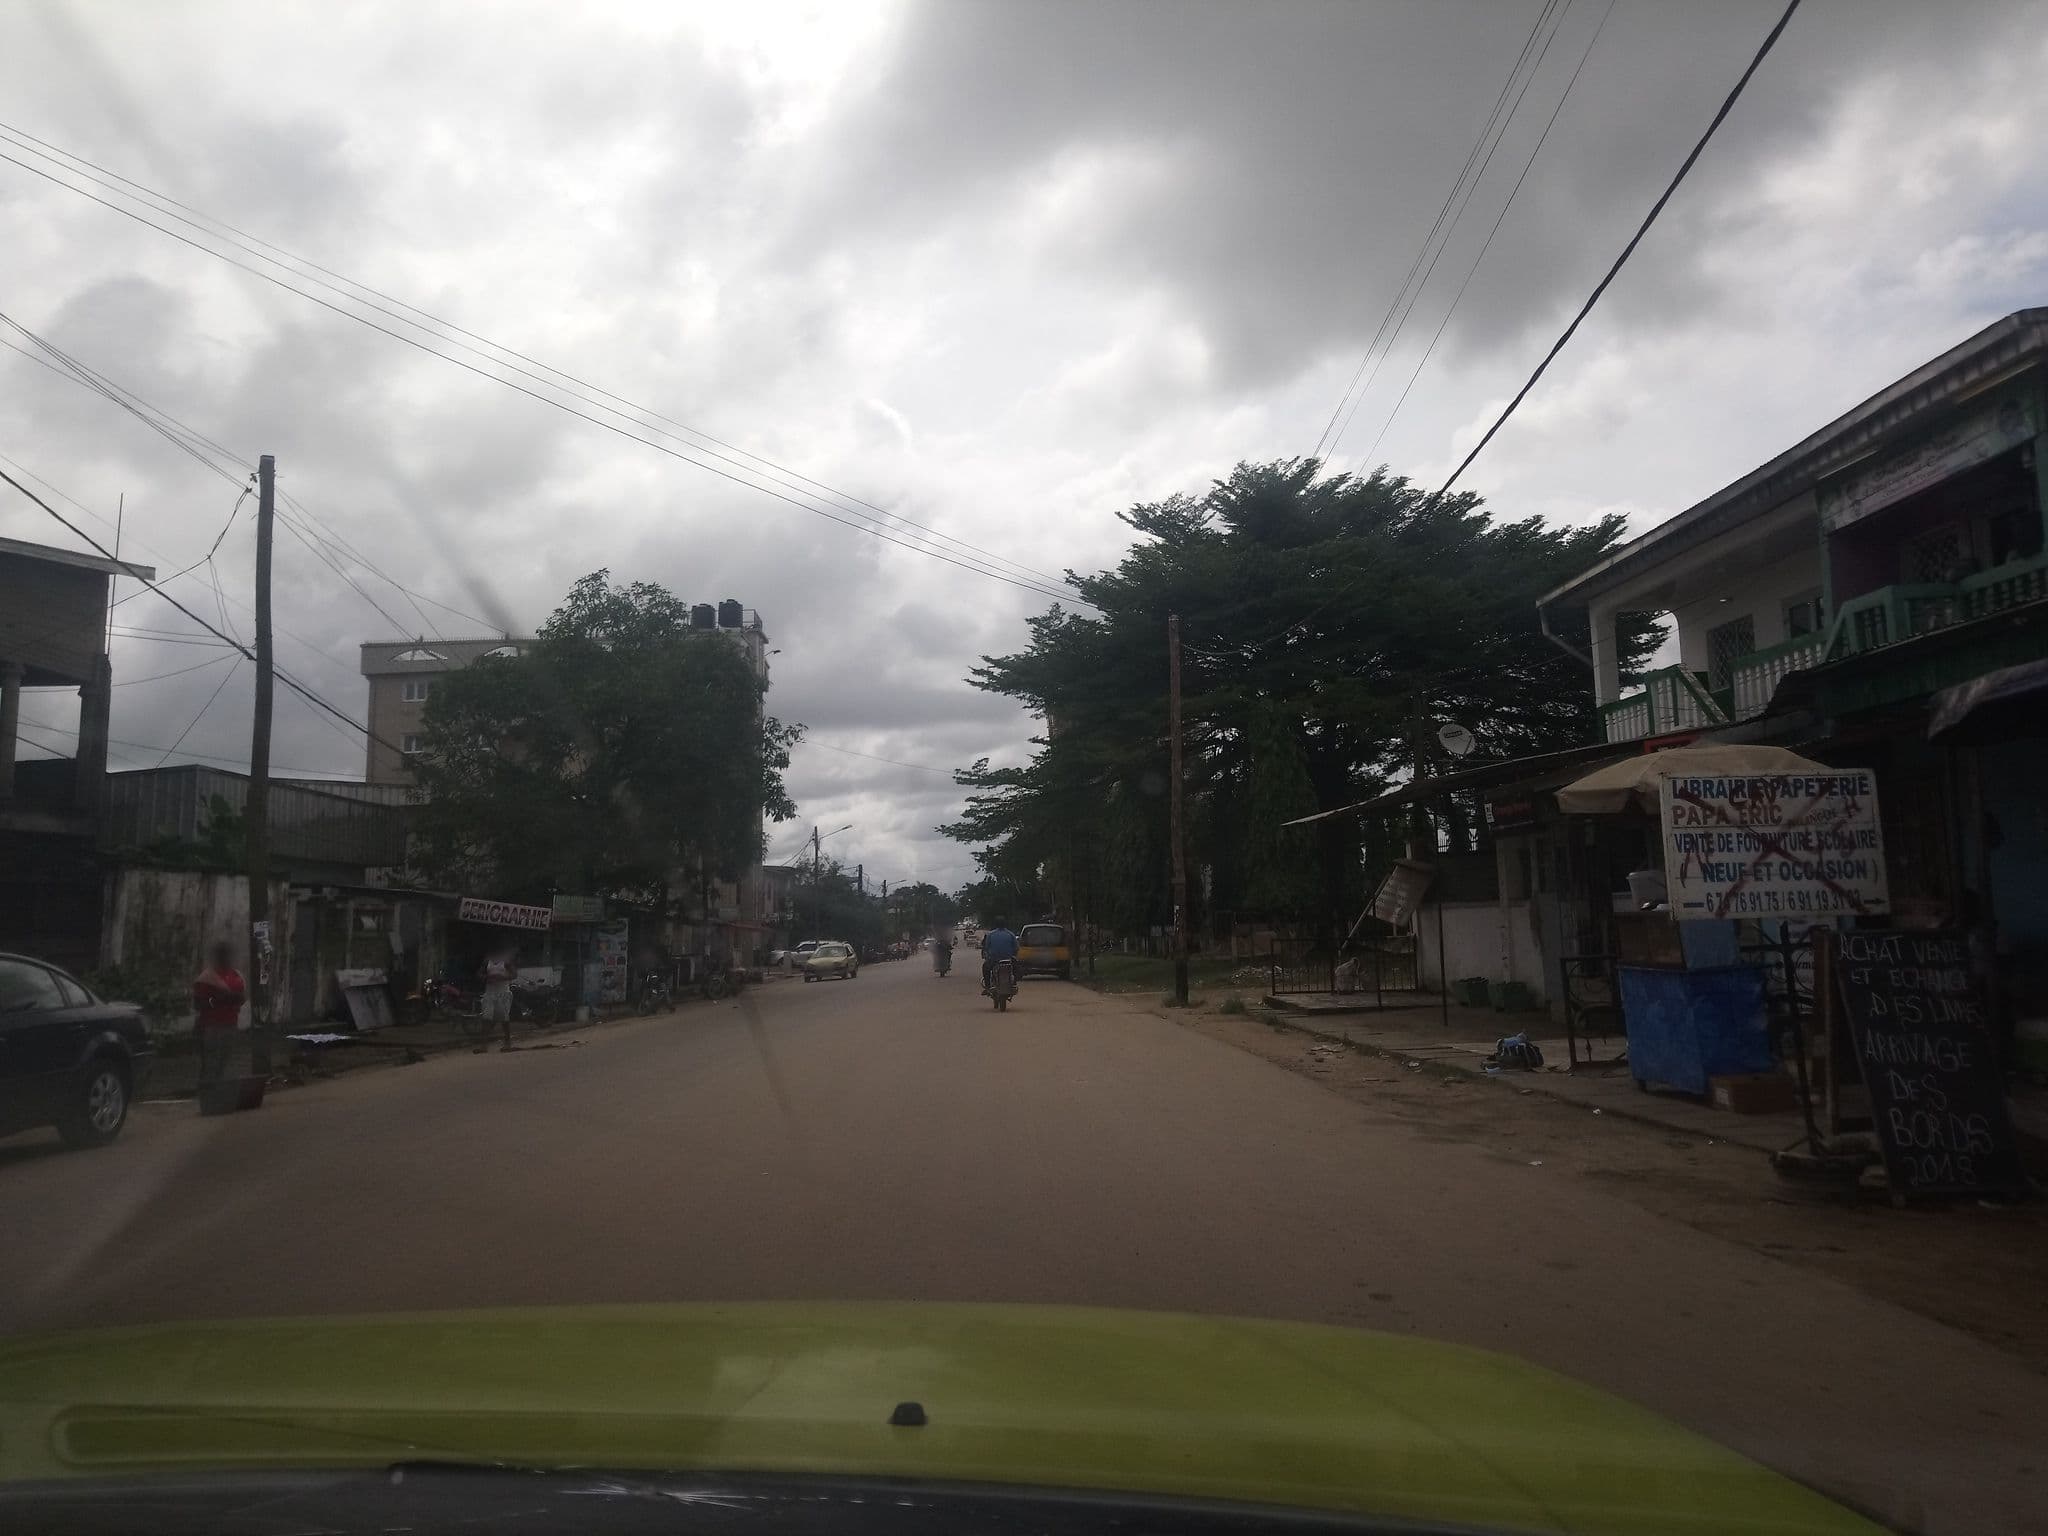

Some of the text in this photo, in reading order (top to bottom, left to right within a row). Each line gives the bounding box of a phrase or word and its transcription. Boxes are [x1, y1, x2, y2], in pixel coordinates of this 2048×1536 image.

[1671, 804, 1784, 826] PAPA ERIC
[1674, 829, 1877, 854] VENTE DE FOURNITURE SCOLAIRE
[1702, 861, 1746, 883] NEUF
[1752, 861, 1775, 882] ET
[1779, 860, 1868, 882] OCCASION
[1840, 934, 1904, 964] ACHAT
[1848, 967, 1872, 985] ET
[1870, 992, 1923, 1026] DES
